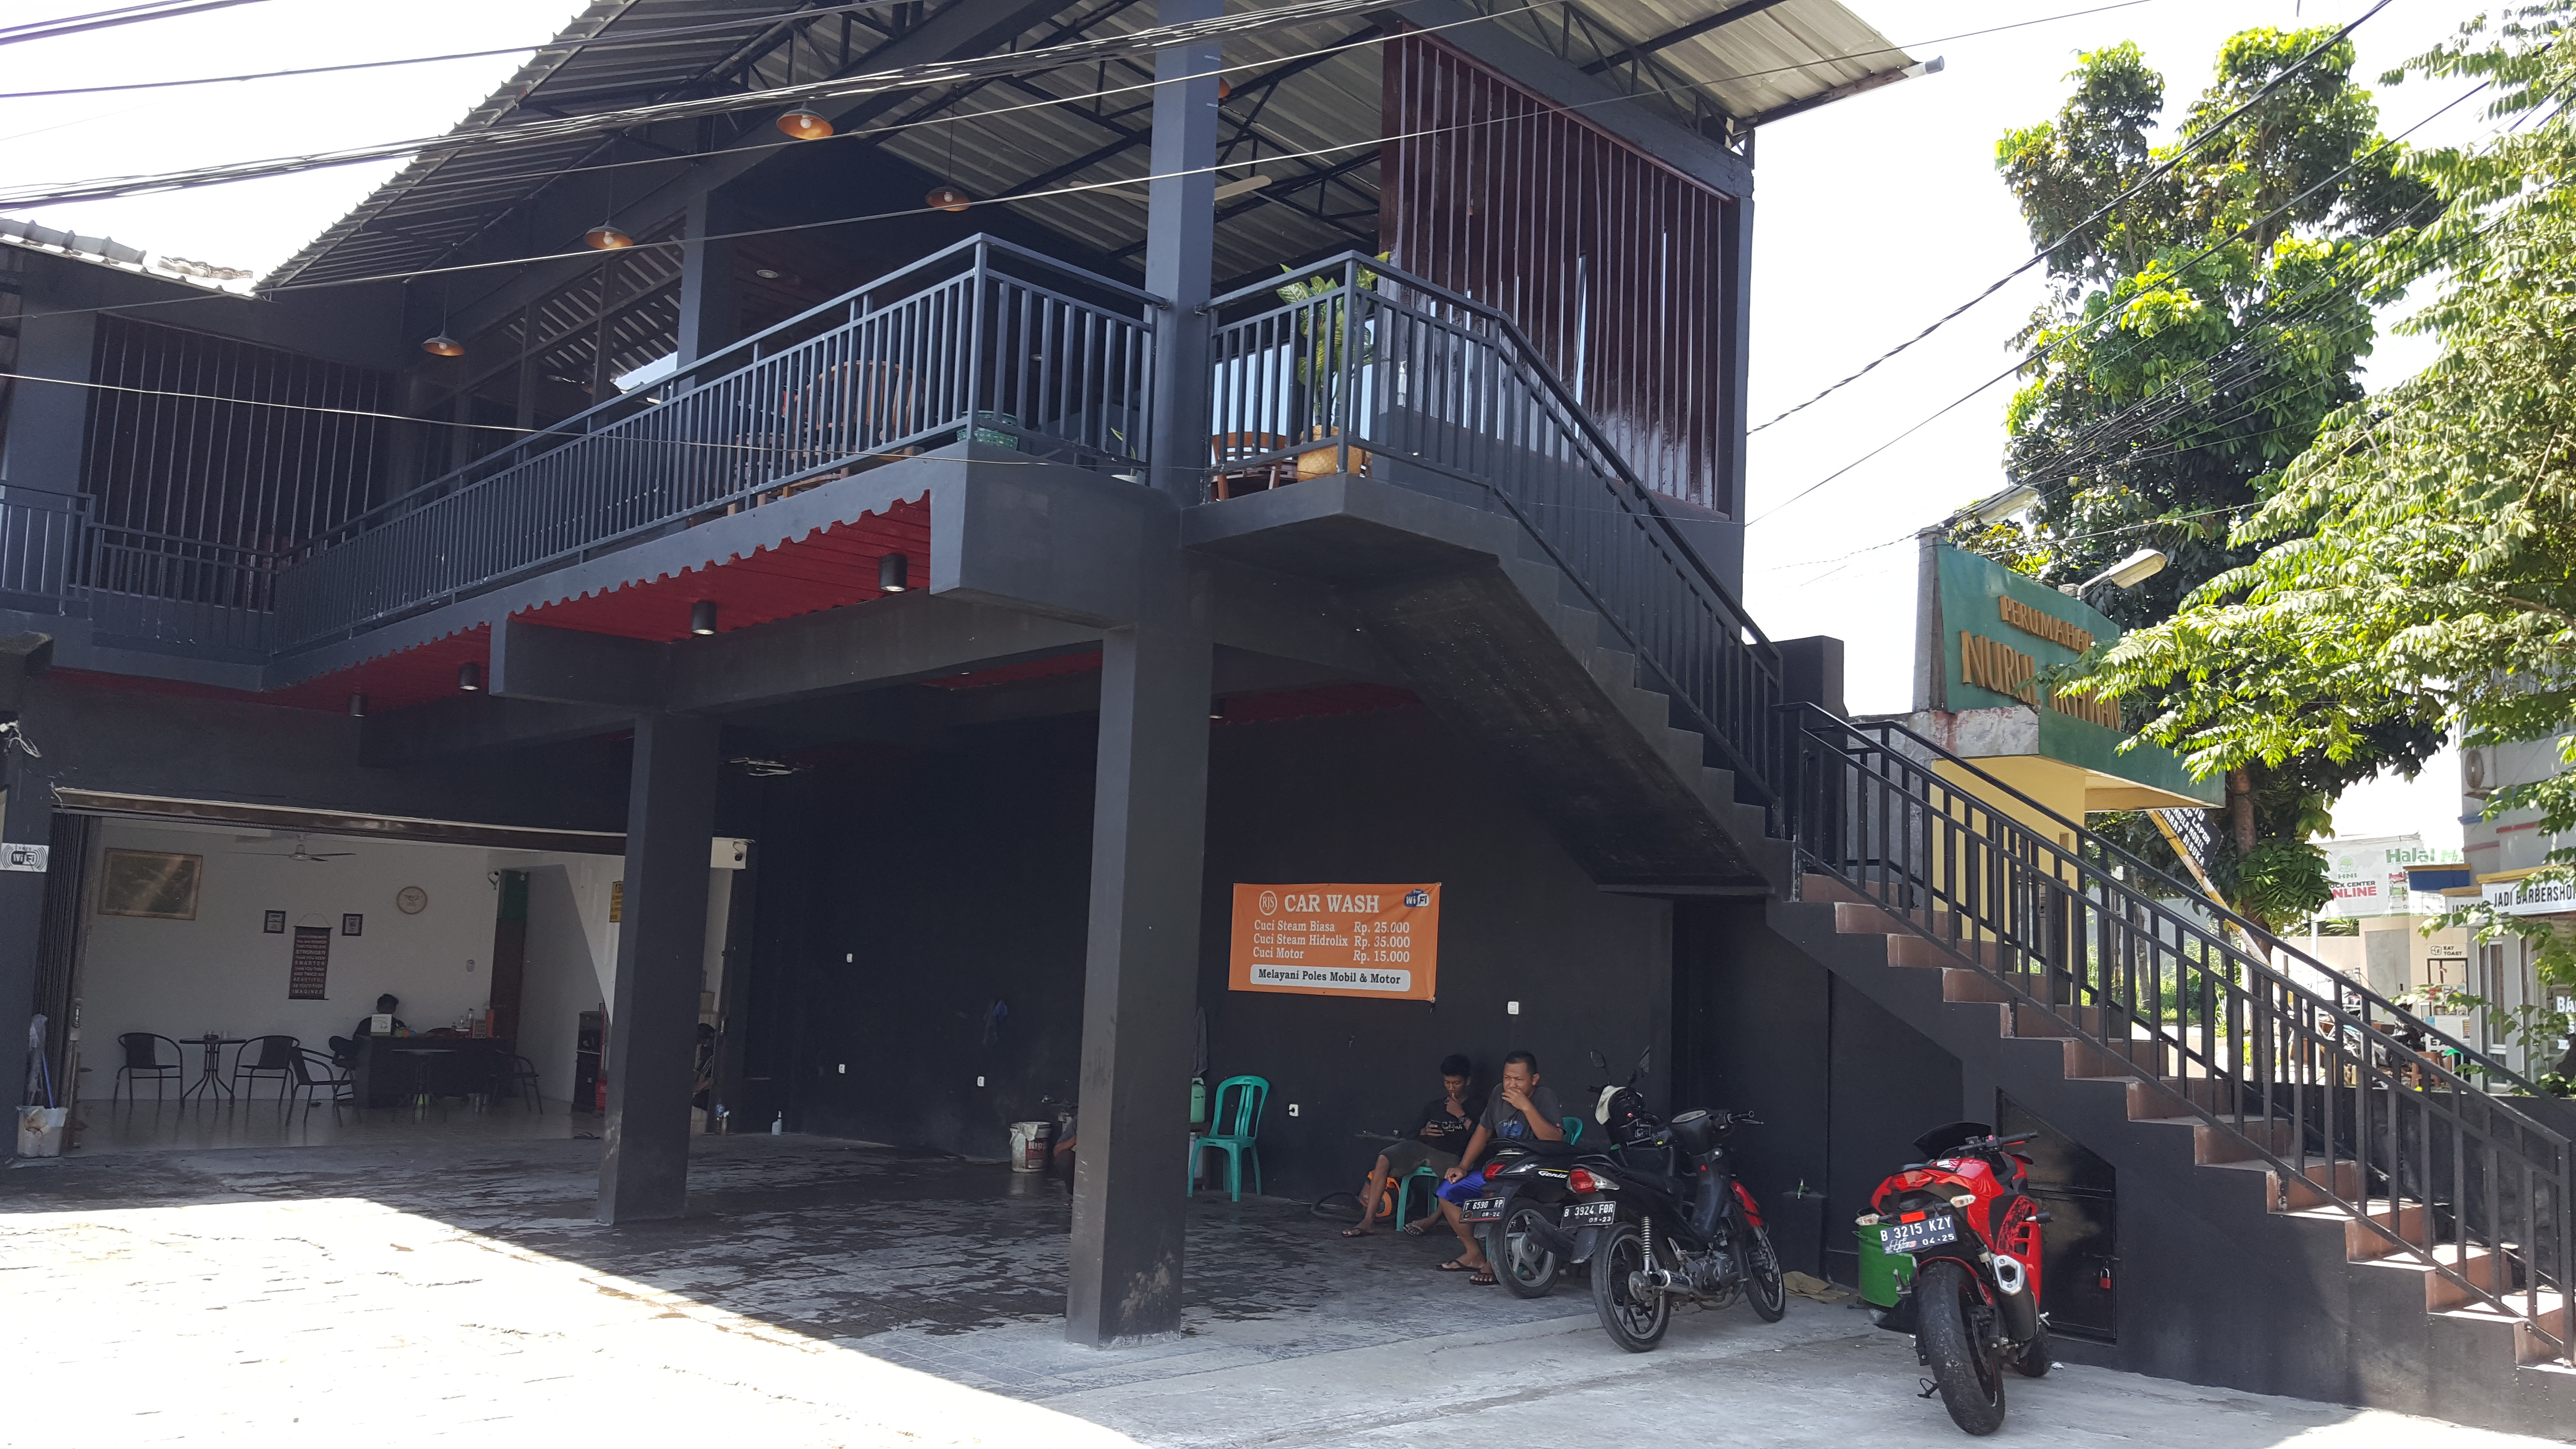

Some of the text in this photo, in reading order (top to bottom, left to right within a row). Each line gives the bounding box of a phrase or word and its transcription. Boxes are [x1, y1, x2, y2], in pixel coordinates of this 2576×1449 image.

[1999, 595, 2094, 654] PERUMAHAN
[1961, 630, 2042, 706] NURUL
[2188, 826, 2204, 852] MOBIL
[2191, 817, 2210, 845] LAPOR
[2189, 841, 2205, 866] BUKA
[2385, 847, 2435, 864] Halal
[2332, 886, 2377, 899] NLINE
[2494, 890, 2513, 908] JADI
[1262, 896, 1274, 911] RJS
[1285, 894, 1379, 913] CAR WASH
[1254, 919, 1410, 935] Cuci Steam Biasa Rp. 25.000
[1254, 933, 1410, 950] Cuci Steam Hidrolix Rp. 35.000
[1253, 947, 1410, 964] Cuci Motor Rp. 15.000
[1258, 969, 1401, 984] Melayani Poles Mobil & Motor
[1472, 1201, 1489, 1209] 6590
[1564, 1208, 1570, 1217] B
[1574, 1205, 1594, 1216] 3924
[1880, 1216, 1950, 1241] B 3215 KZY
